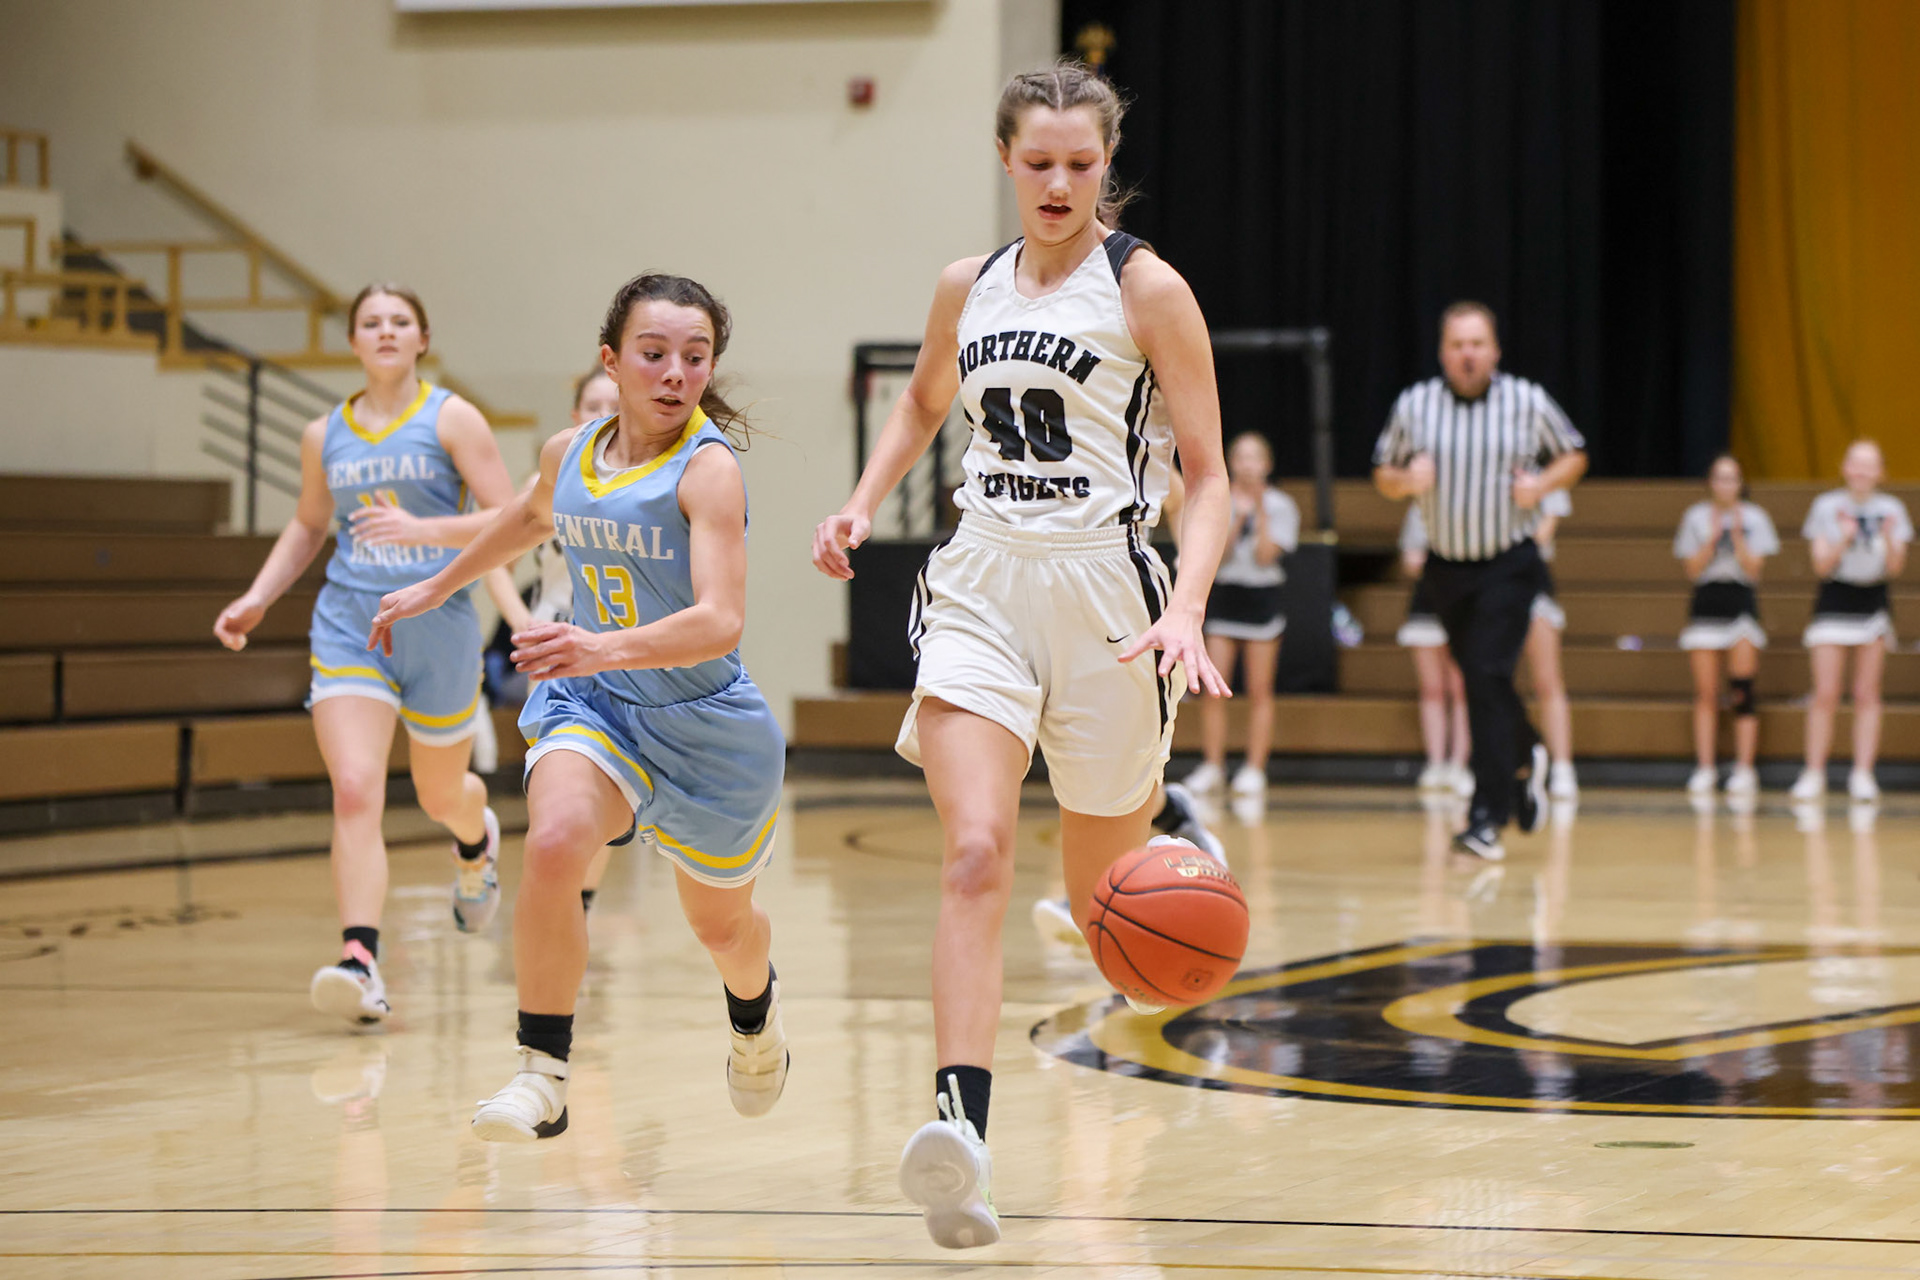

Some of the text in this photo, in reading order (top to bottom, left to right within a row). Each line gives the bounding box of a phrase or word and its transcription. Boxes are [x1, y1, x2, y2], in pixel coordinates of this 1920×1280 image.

[980, 387, 1073, 462] 40
[328, 454, 436, 490] ENTRAL
[552, 512, 675, 560] ENTRAL
[581, 563, 640, 629] 13
